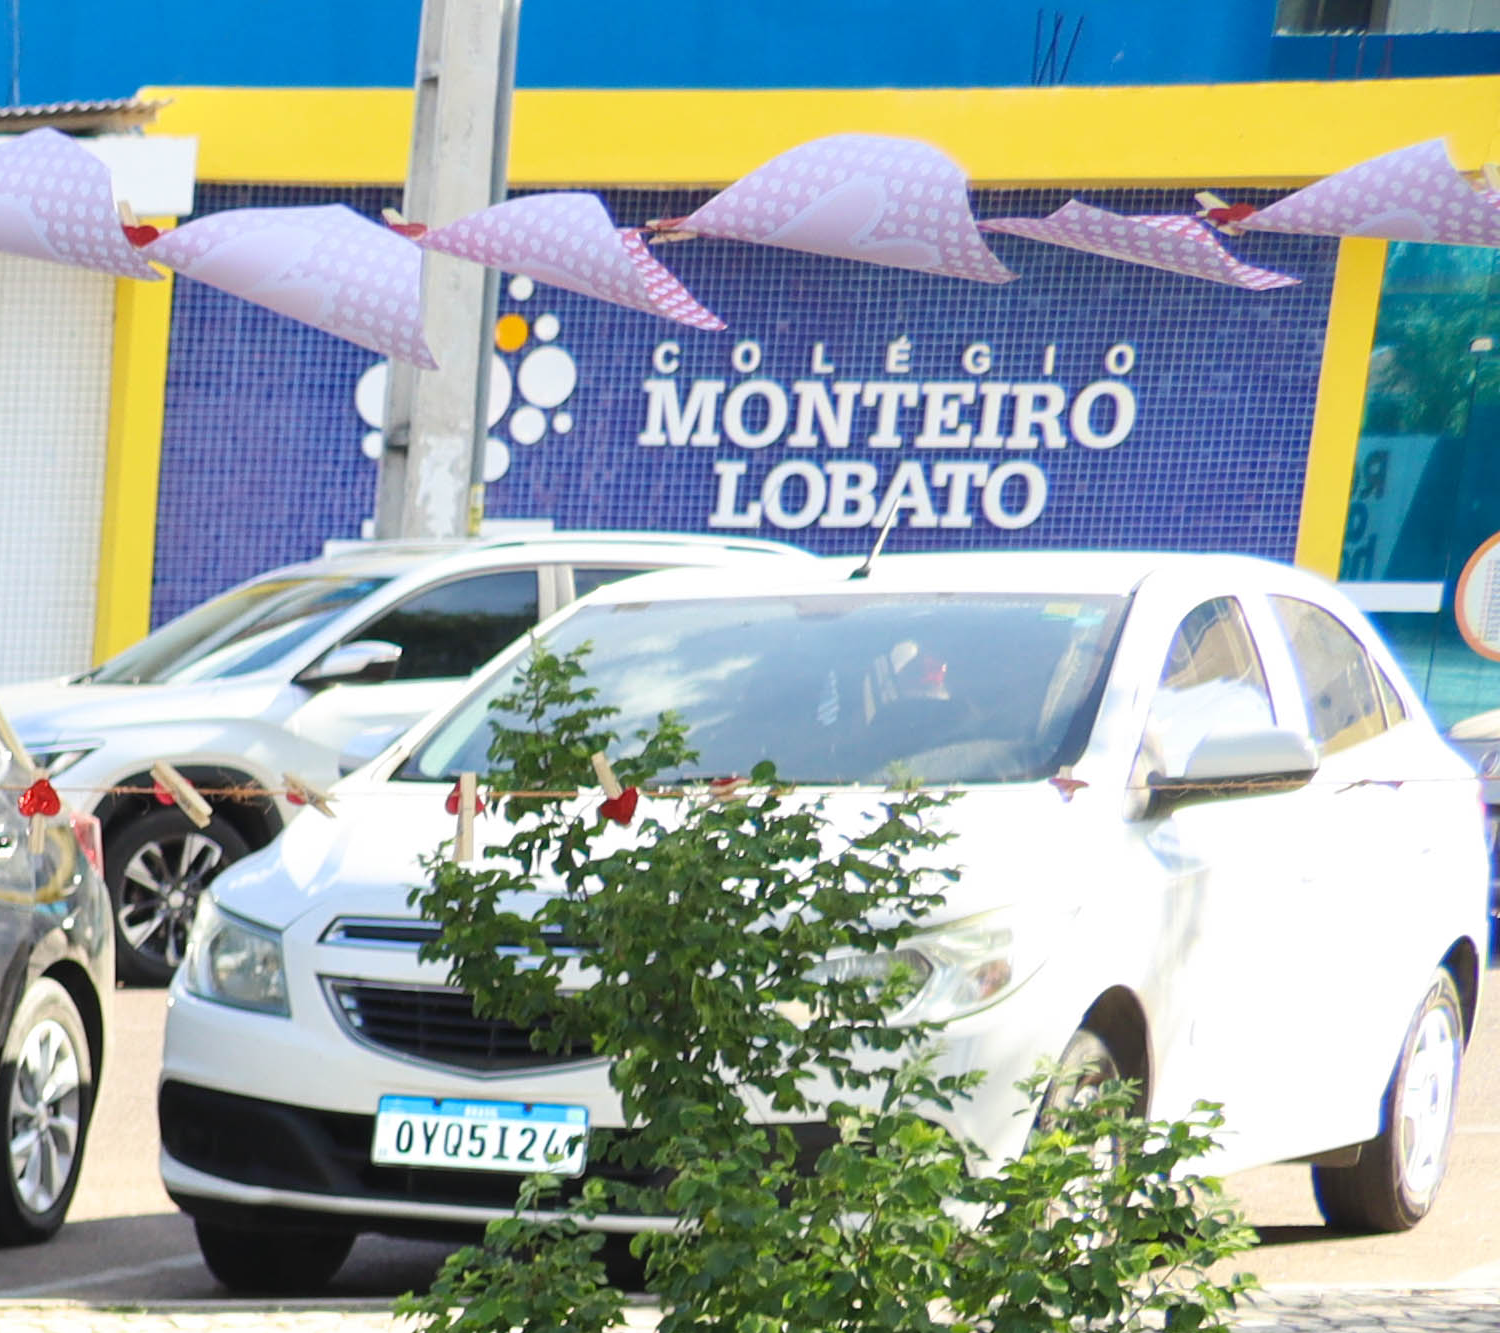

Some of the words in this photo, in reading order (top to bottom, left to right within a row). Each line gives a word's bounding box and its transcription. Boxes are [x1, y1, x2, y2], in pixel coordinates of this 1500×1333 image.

[652, 336, 1135, 375] COLÉGIO
[638, 378, 1138, 450] MONTEIRO
[709, 460, 1048, 530] LOBATO
